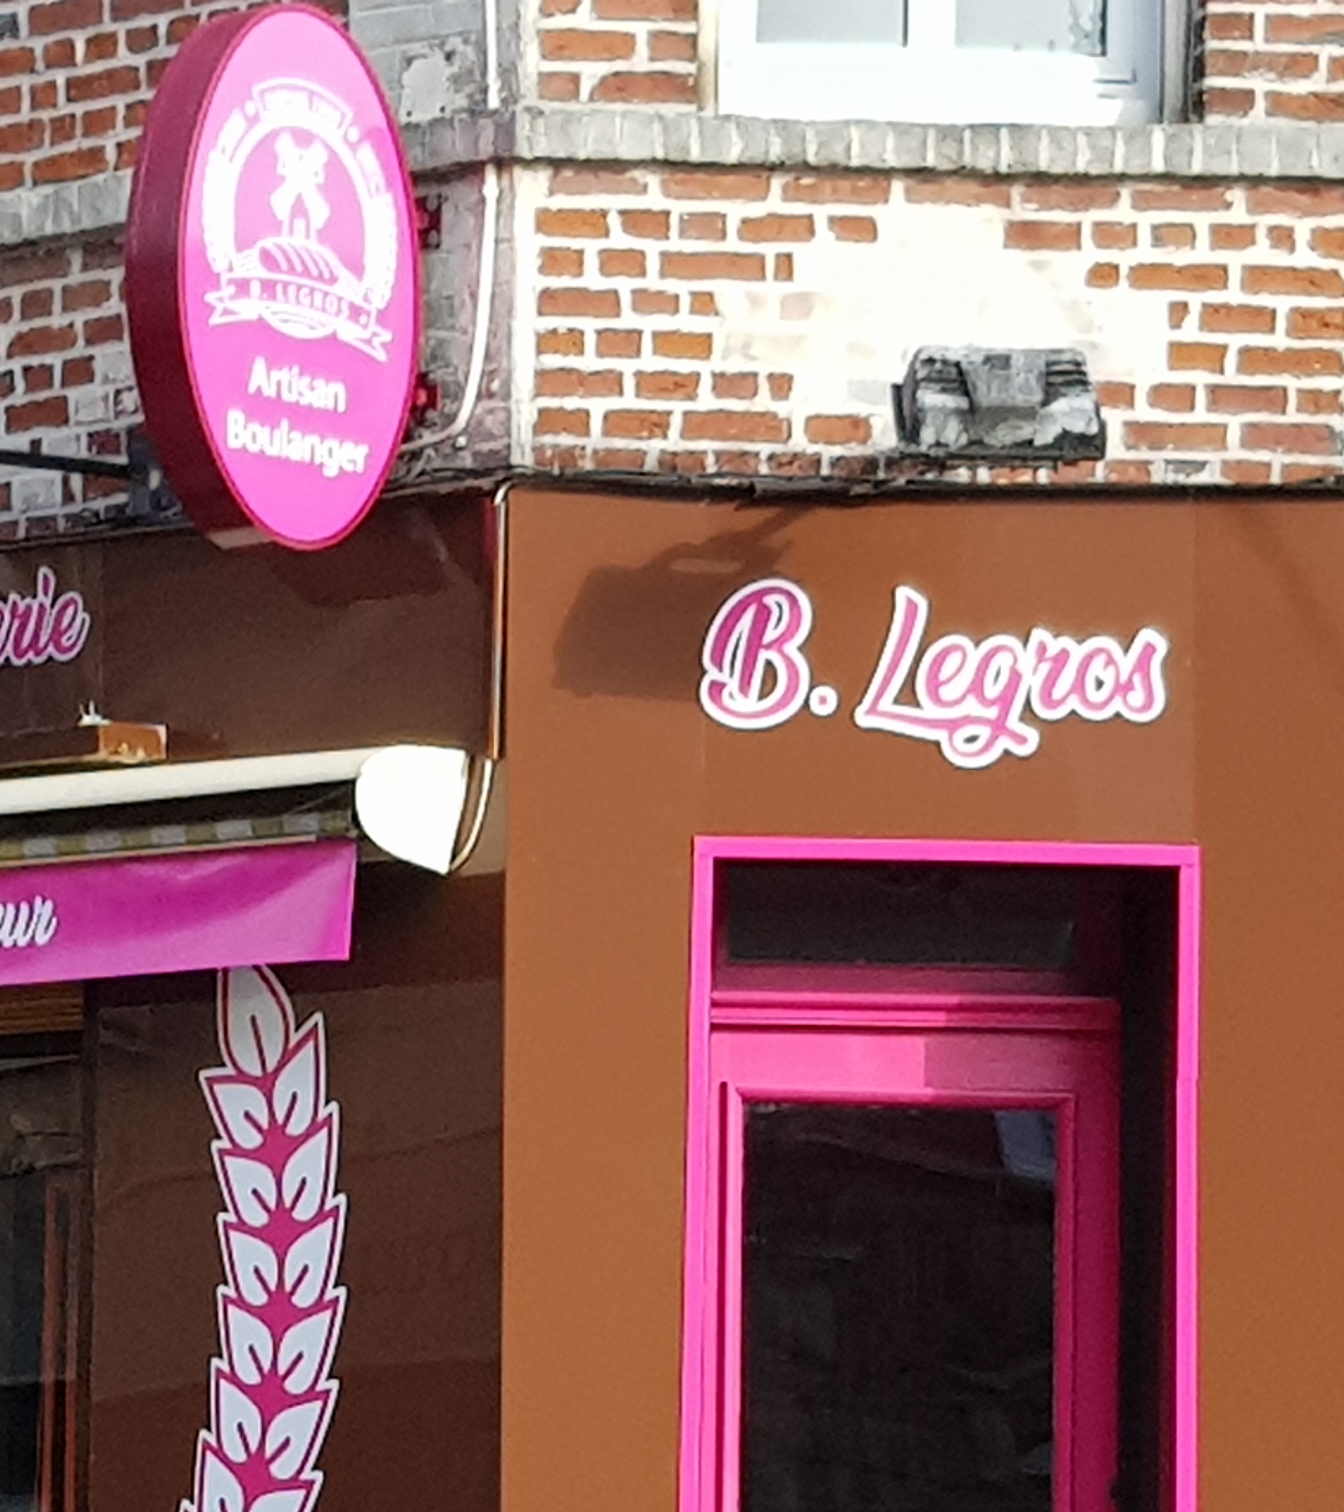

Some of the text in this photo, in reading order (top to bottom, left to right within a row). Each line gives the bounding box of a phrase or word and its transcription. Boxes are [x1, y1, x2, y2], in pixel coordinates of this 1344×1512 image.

[275, 282, 350, 319] LEGROS
[248, 356, 347, 413] Artisan
[226, 410, 368, 478] Boulanger
[699, 577, 1170, 770] B. Legros
